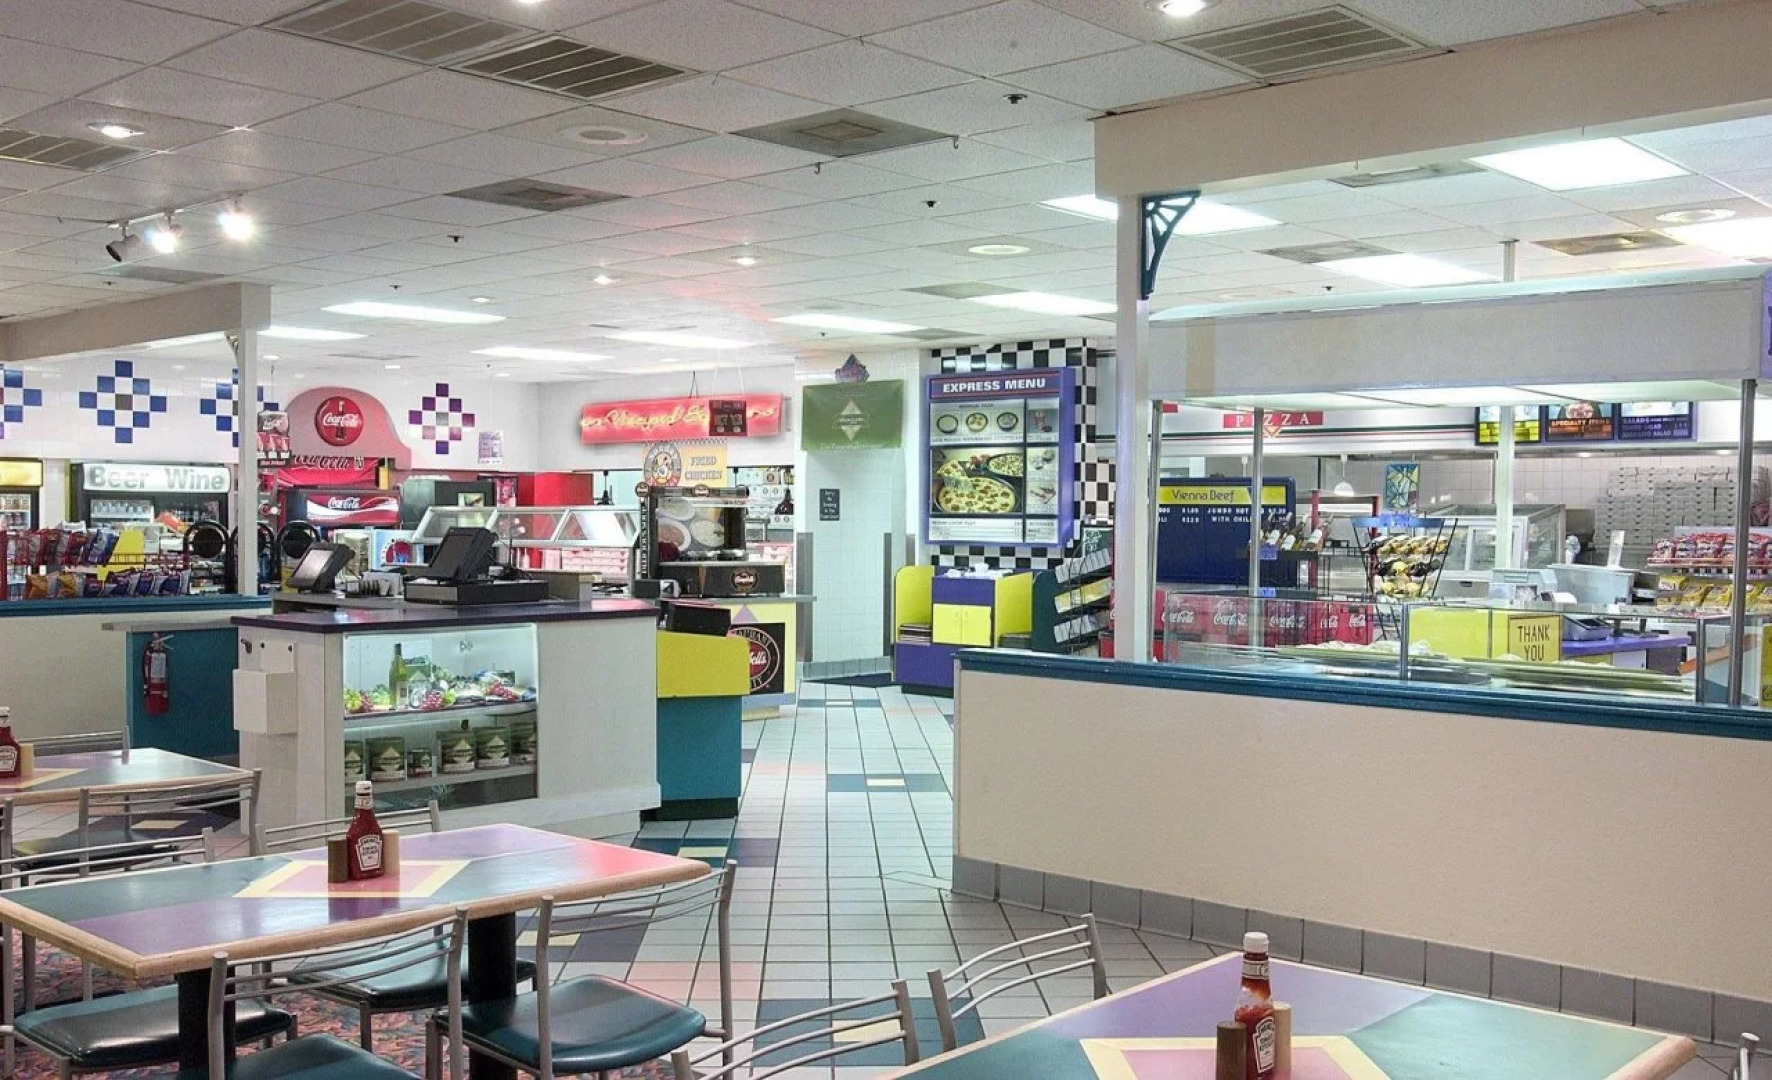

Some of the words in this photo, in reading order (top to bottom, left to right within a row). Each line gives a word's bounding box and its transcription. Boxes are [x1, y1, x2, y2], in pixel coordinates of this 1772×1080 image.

[943, 382, 1000, 393] EXPRESS
[1004, 377, 1046, 390] MENU
[323, 412, 359, 427] Coca-Cola
[607, 405, 684, 432] Vineyard
[1236, 413, 1310, 427] PZZA
[690, 455, 717, 466] FRIED
[89, 466, 150, 489] Beer
[165, 467, 225, 490] Wine
[684, 470, 723, 481] CHICKEN
[1172, 489, 1208, 501] Vienna
[1210, 489, 1235, 503] Beef
[1517, 624, 1550, 643] THANK
[1524, 644, 1545, 662] YOU
